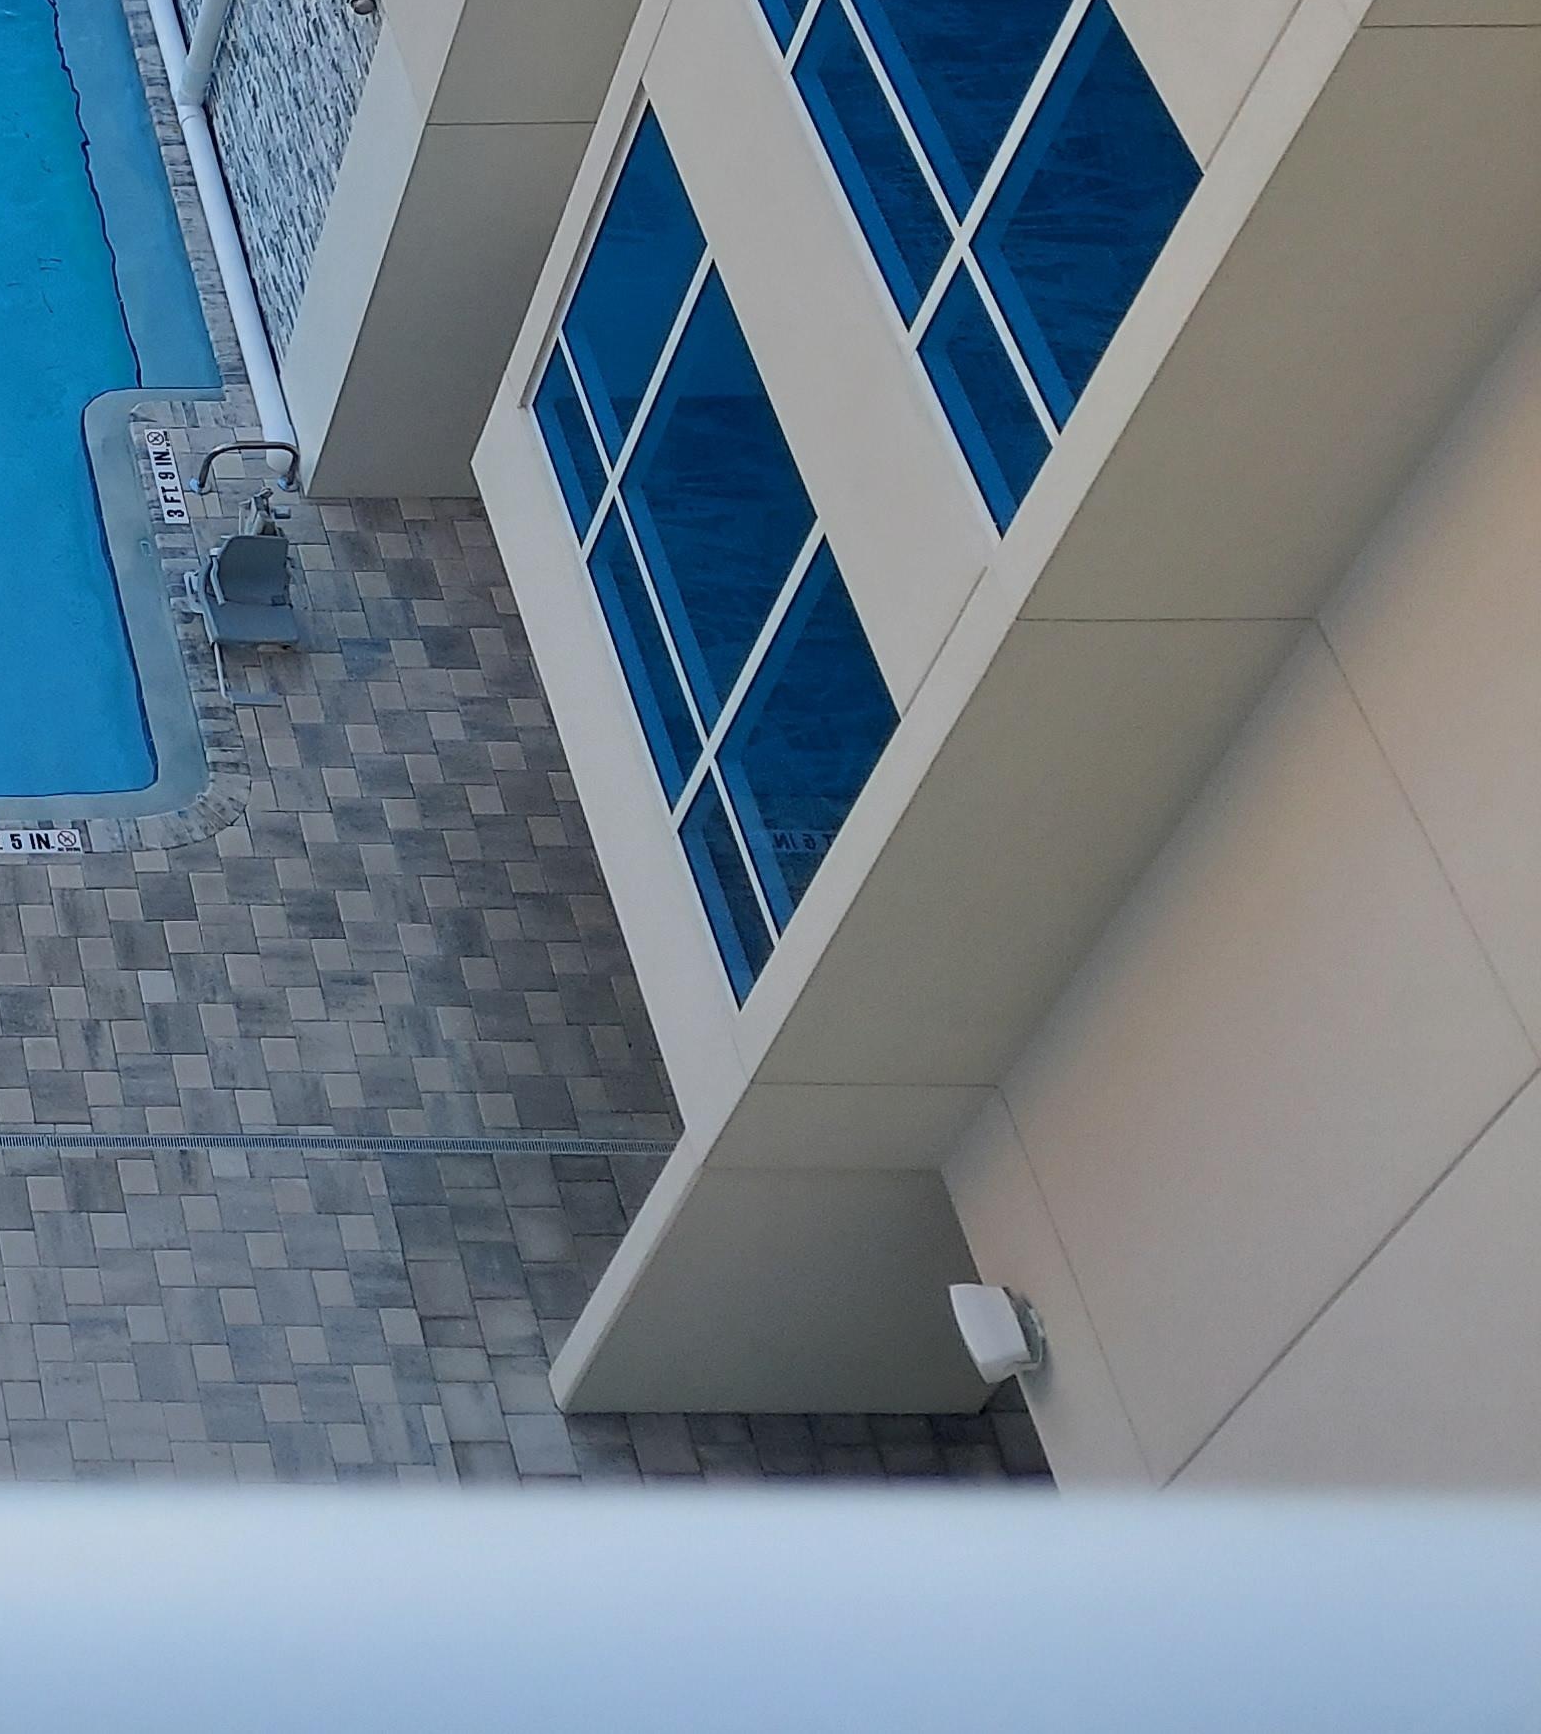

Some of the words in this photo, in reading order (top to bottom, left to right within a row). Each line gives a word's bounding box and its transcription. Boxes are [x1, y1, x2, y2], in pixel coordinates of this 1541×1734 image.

[157, 471, 176, 480] 9
[166, 508, 185, 518] 3
[10, 833, 23, 850] 5
